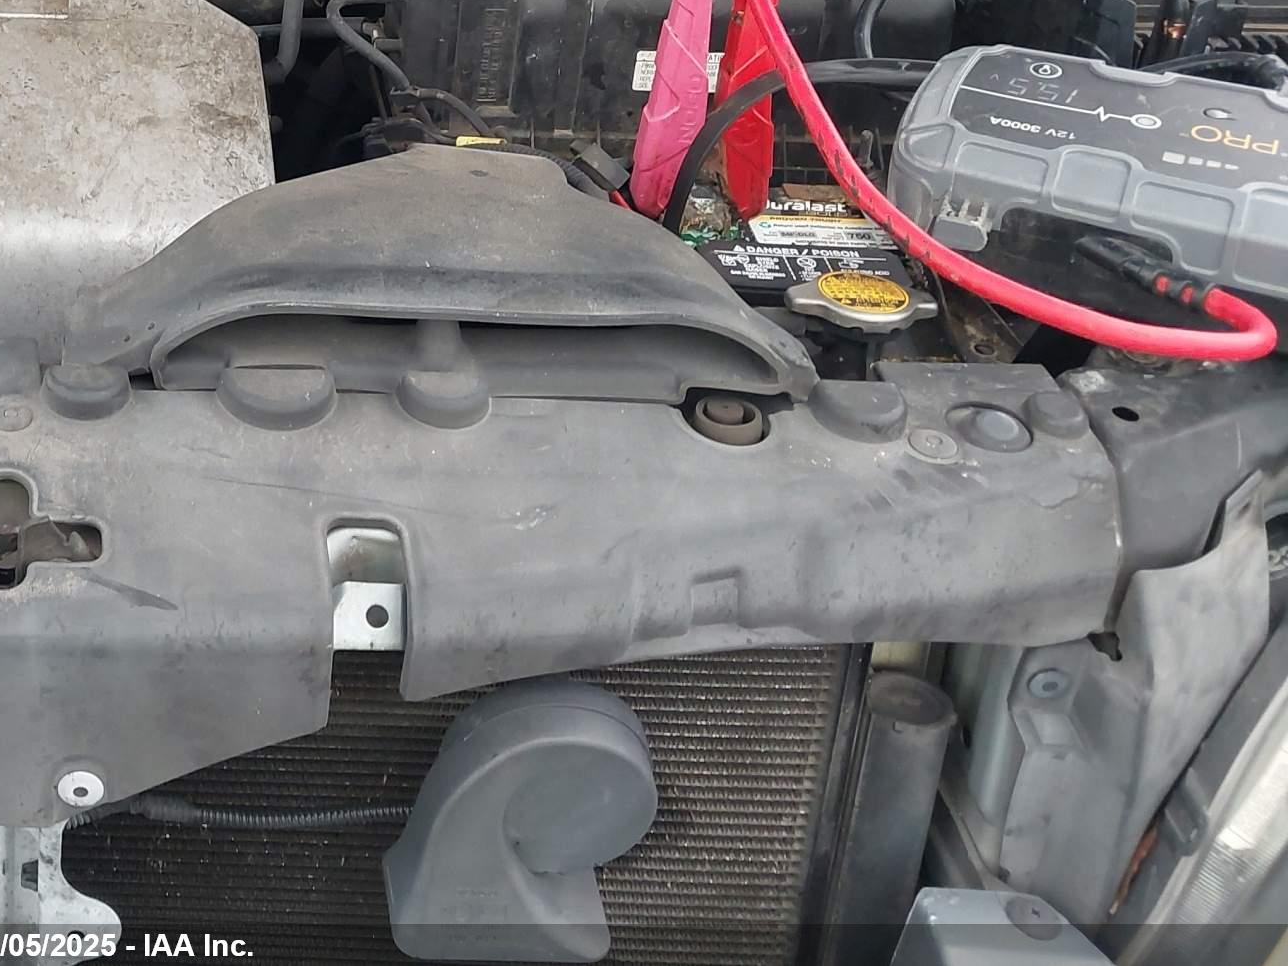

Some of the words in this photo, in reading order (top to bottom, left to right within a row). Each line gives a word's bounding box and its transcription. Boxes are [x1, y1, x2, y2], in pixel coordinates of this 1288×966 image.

[990, 116, 1041, 133] 3000A
[1045, 128, 1076, 139] 12V
[1191, 125, 1279, 154] PRO
[746, 246, 800, 255] DANGER
[812, 249, 860, 257] POISON
